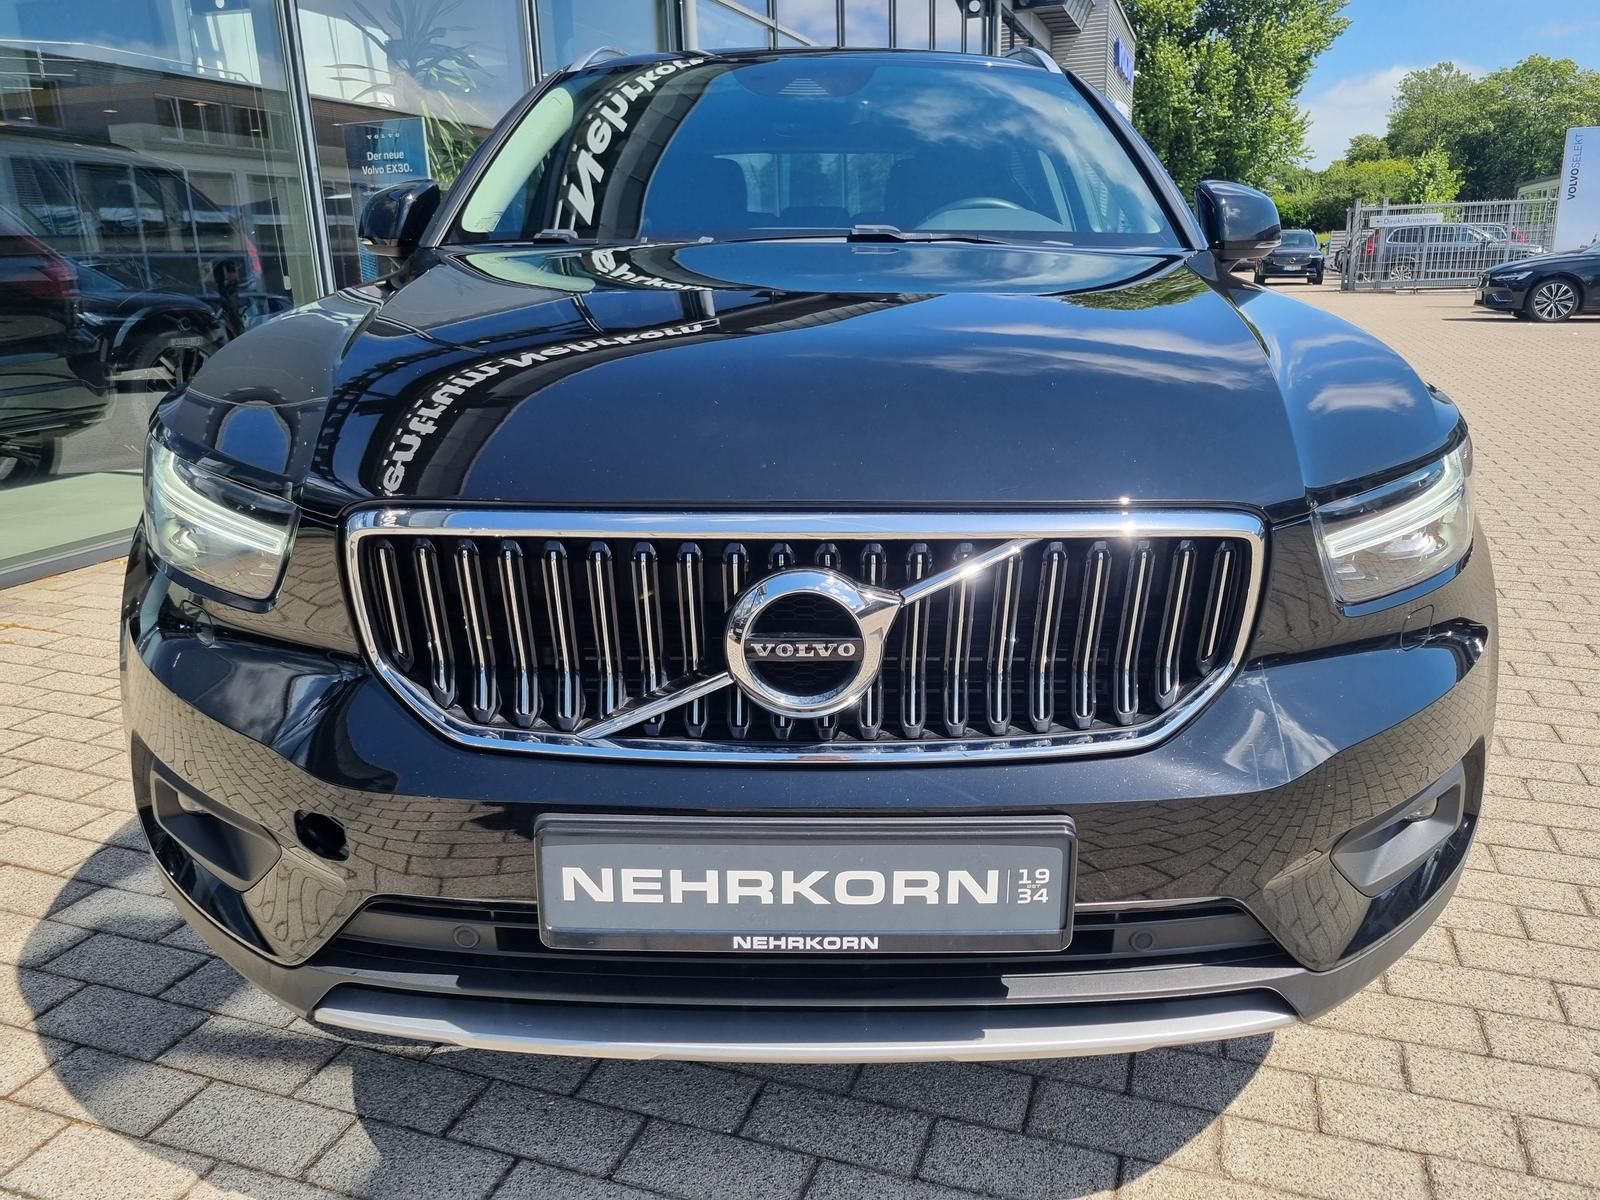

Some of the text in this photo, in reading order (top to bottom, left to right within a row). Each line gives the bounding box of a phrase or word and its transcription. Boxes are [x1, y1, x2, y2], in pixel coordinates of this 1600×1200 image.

[366, 151, 405, 161] Der neue
[362, 163, 413, 175] Volvo EX30.
[750, 643, 856, 657] VOLVO
[561, 866, 1050, 905] NEHRKORN 19
[1017, 888, 1049, 904] 34
[733, 935, 879, 951] NEHRKORN
